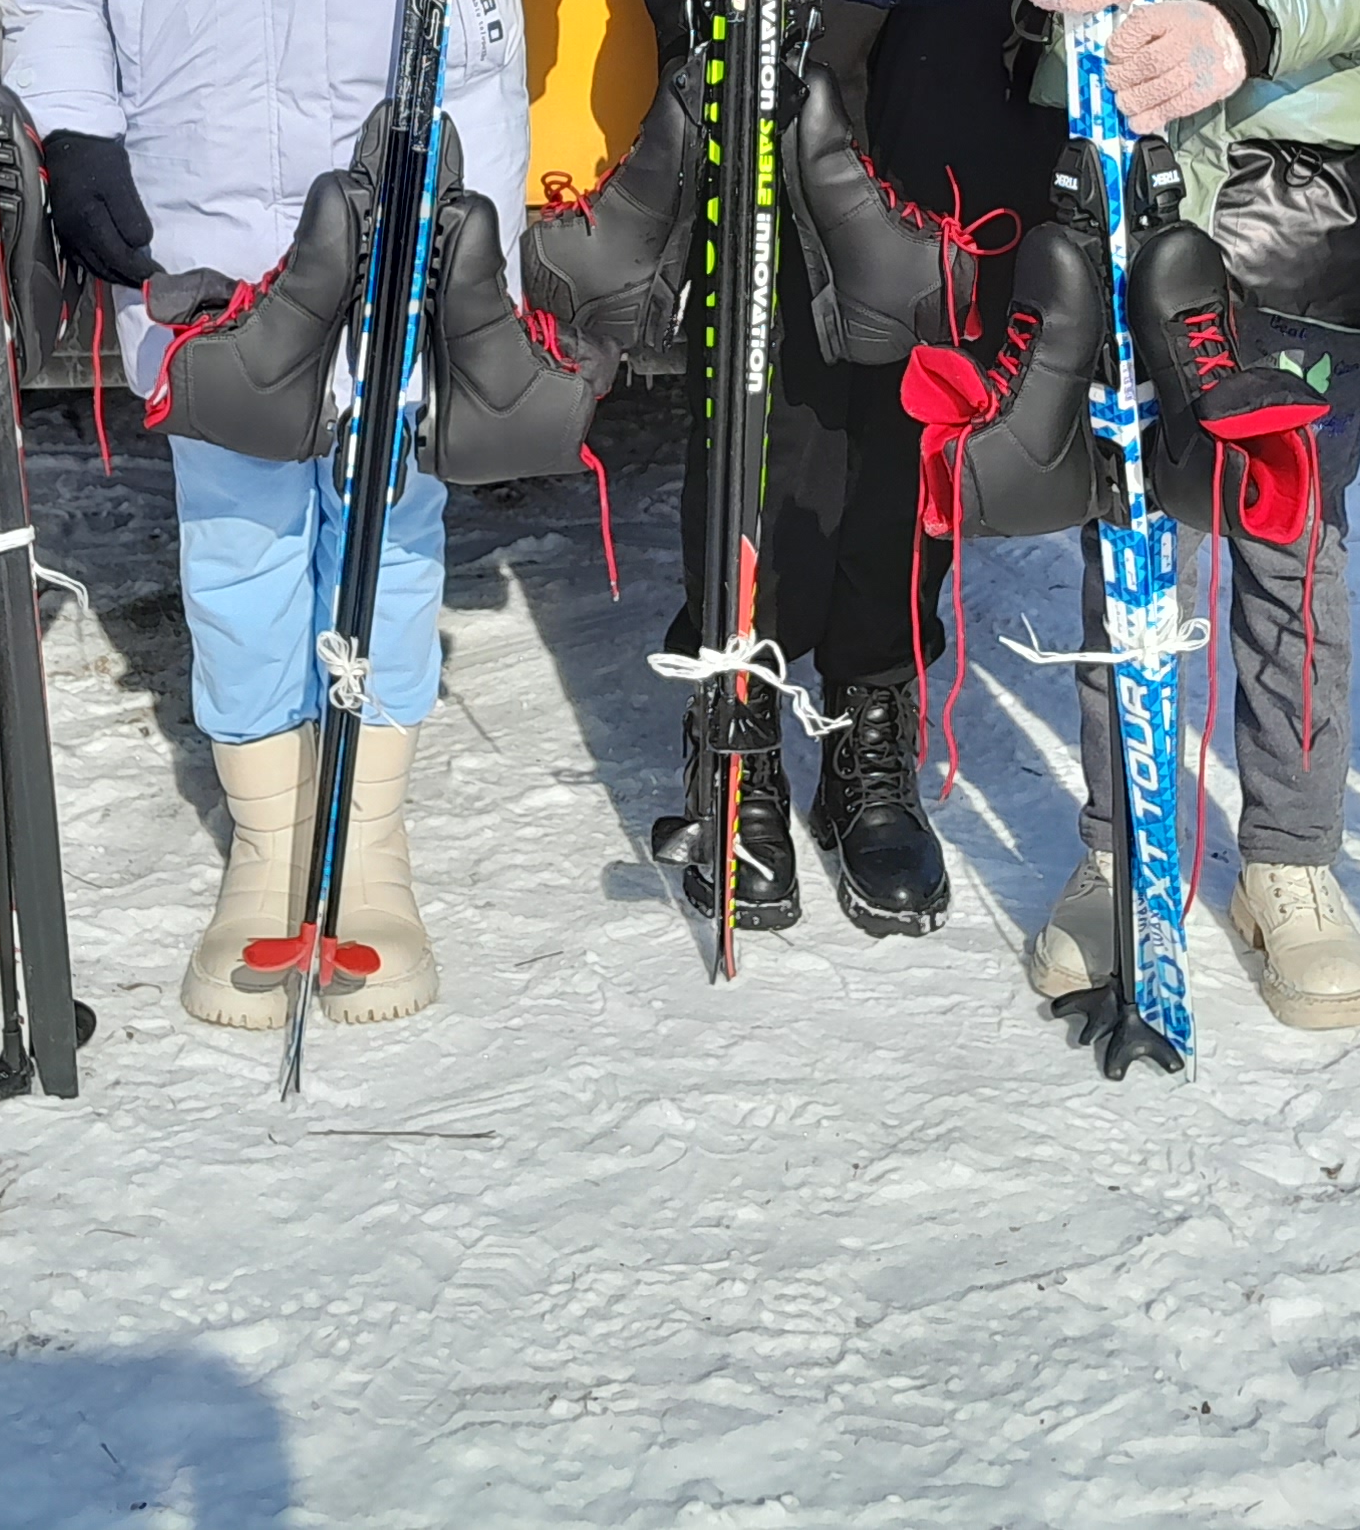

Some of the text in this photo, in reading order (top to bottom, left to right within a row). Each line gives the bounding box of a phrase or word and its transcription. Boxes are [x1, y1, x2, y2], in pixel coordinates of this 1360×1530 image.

[757, 117, 774, 207] SABLE
[1054, 172, 1078, 190] TREK
[1151, 169, 1180, 188] TREK
[1120, 674, 1162, 819] TOUR
[1139, 829, 1176, 911] XT
[1156, 955, 1194, 1056] 160
